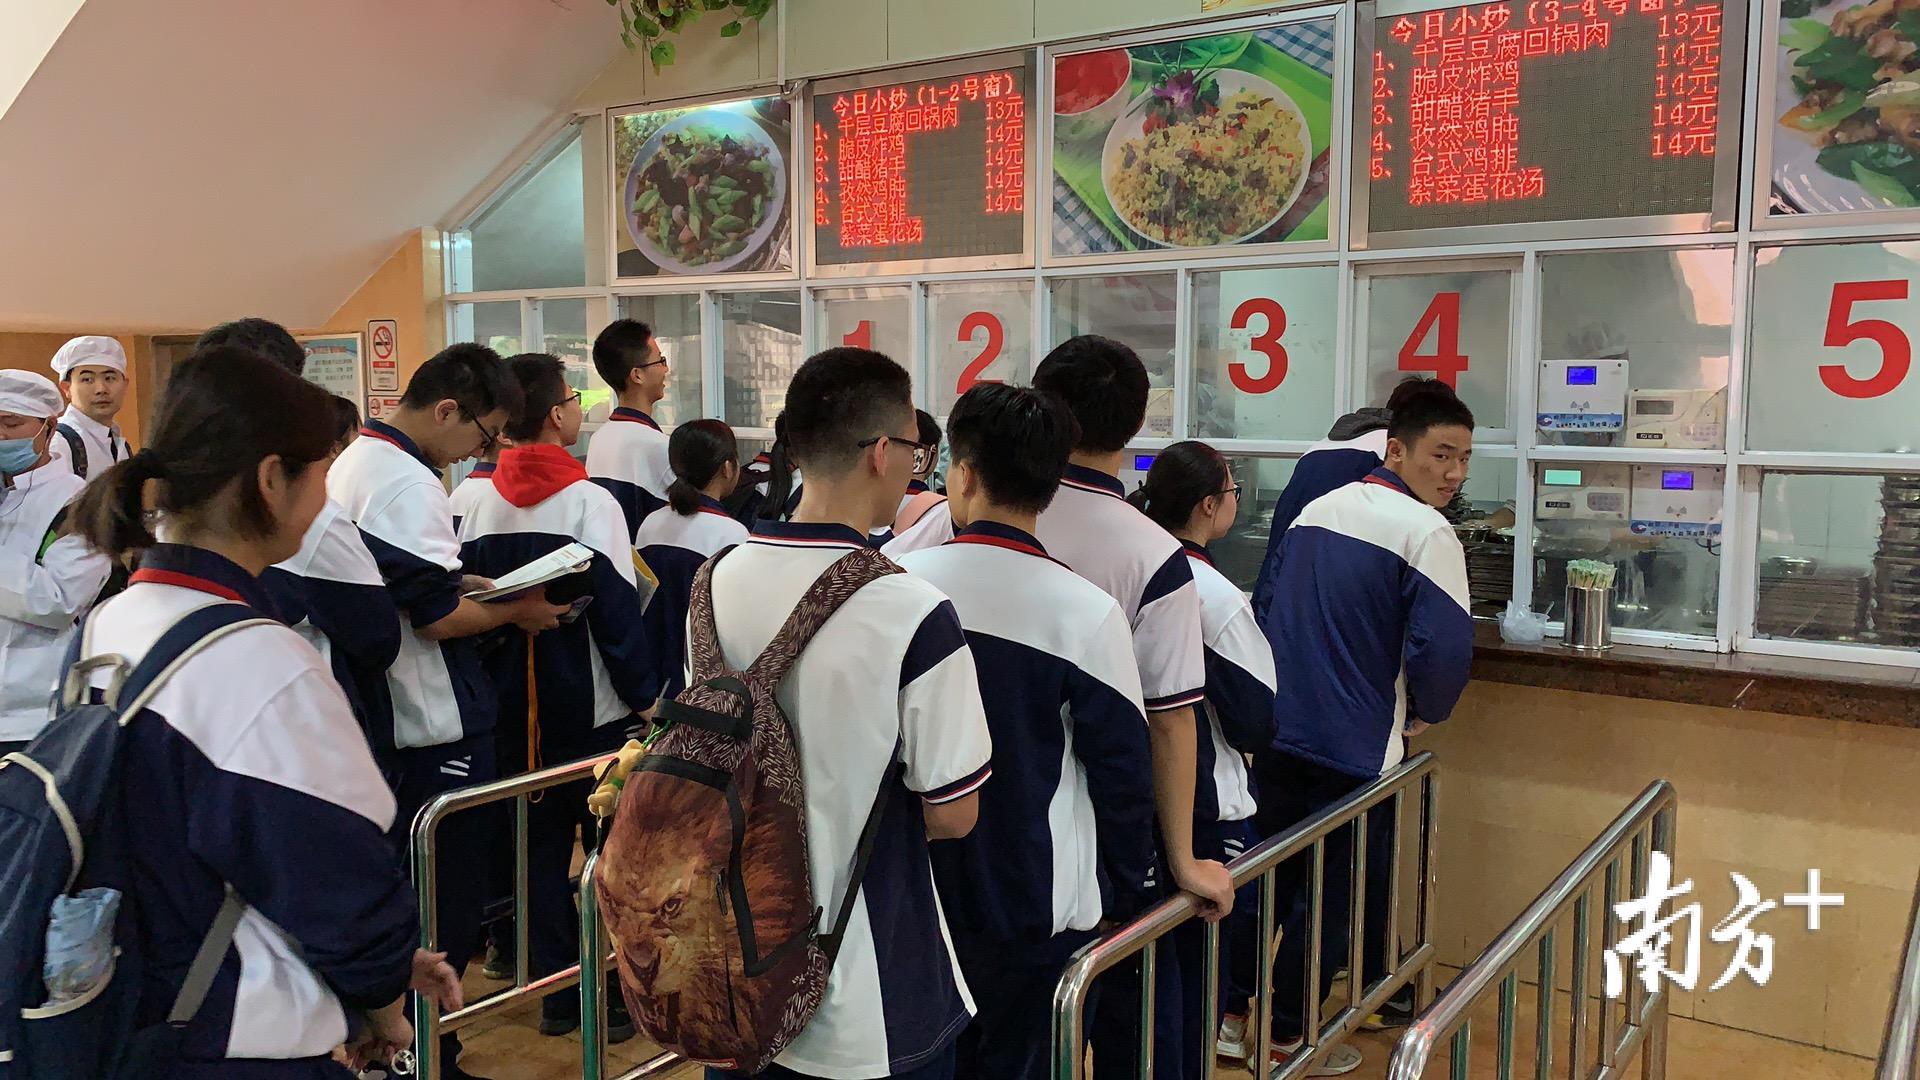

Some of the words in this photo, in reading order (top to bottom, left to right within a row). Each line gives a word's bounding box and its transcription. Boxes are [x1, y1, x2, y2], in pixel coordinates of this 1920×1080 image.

[1413, 18, 1609, 67] 千层豆腐回锅肉
[1659, 5, 1721, 38] 13元
[1412, 60, 1519, 97] 脆皮炸鸡
[1657, 36, 1720, 67] 14元
[1411, 87, 1520, 121] 甜醋猪手
[1655, 66, 1718, 97] 14元
[1653, 96, 1717, 127] 14元
[838, 104, 958, 138] 千层豆腐回锅肉
[986, 96, 1023, 120] 13元
[839, 134, 905, 160] 脆皮炸鸡
[986, 120, 1023, 143] 14元
[839, 156, 906, 181] 甜醋猪手
[986, 143, 1023, 167] 14元
[1412, 143, 1518, 176] 台式鸡排
[1652, 127, 1715, 156] 14元
[985, 166, 1023, 190] 14元
[1410, 168, 1545, 204] 紫菜蛋花汤
[841, 201, 906, 224] 台式鸡排
[985, 190, 1022, 213] 14元
[840, 217, 923, 247] 紫菜蛋花汤
[957, 311, 1004, 395] 2
[1228, 298, 1289, 394] 3
[1398, 292, 1469, 394] 4
[1818, 279, 1912, 399] 5
